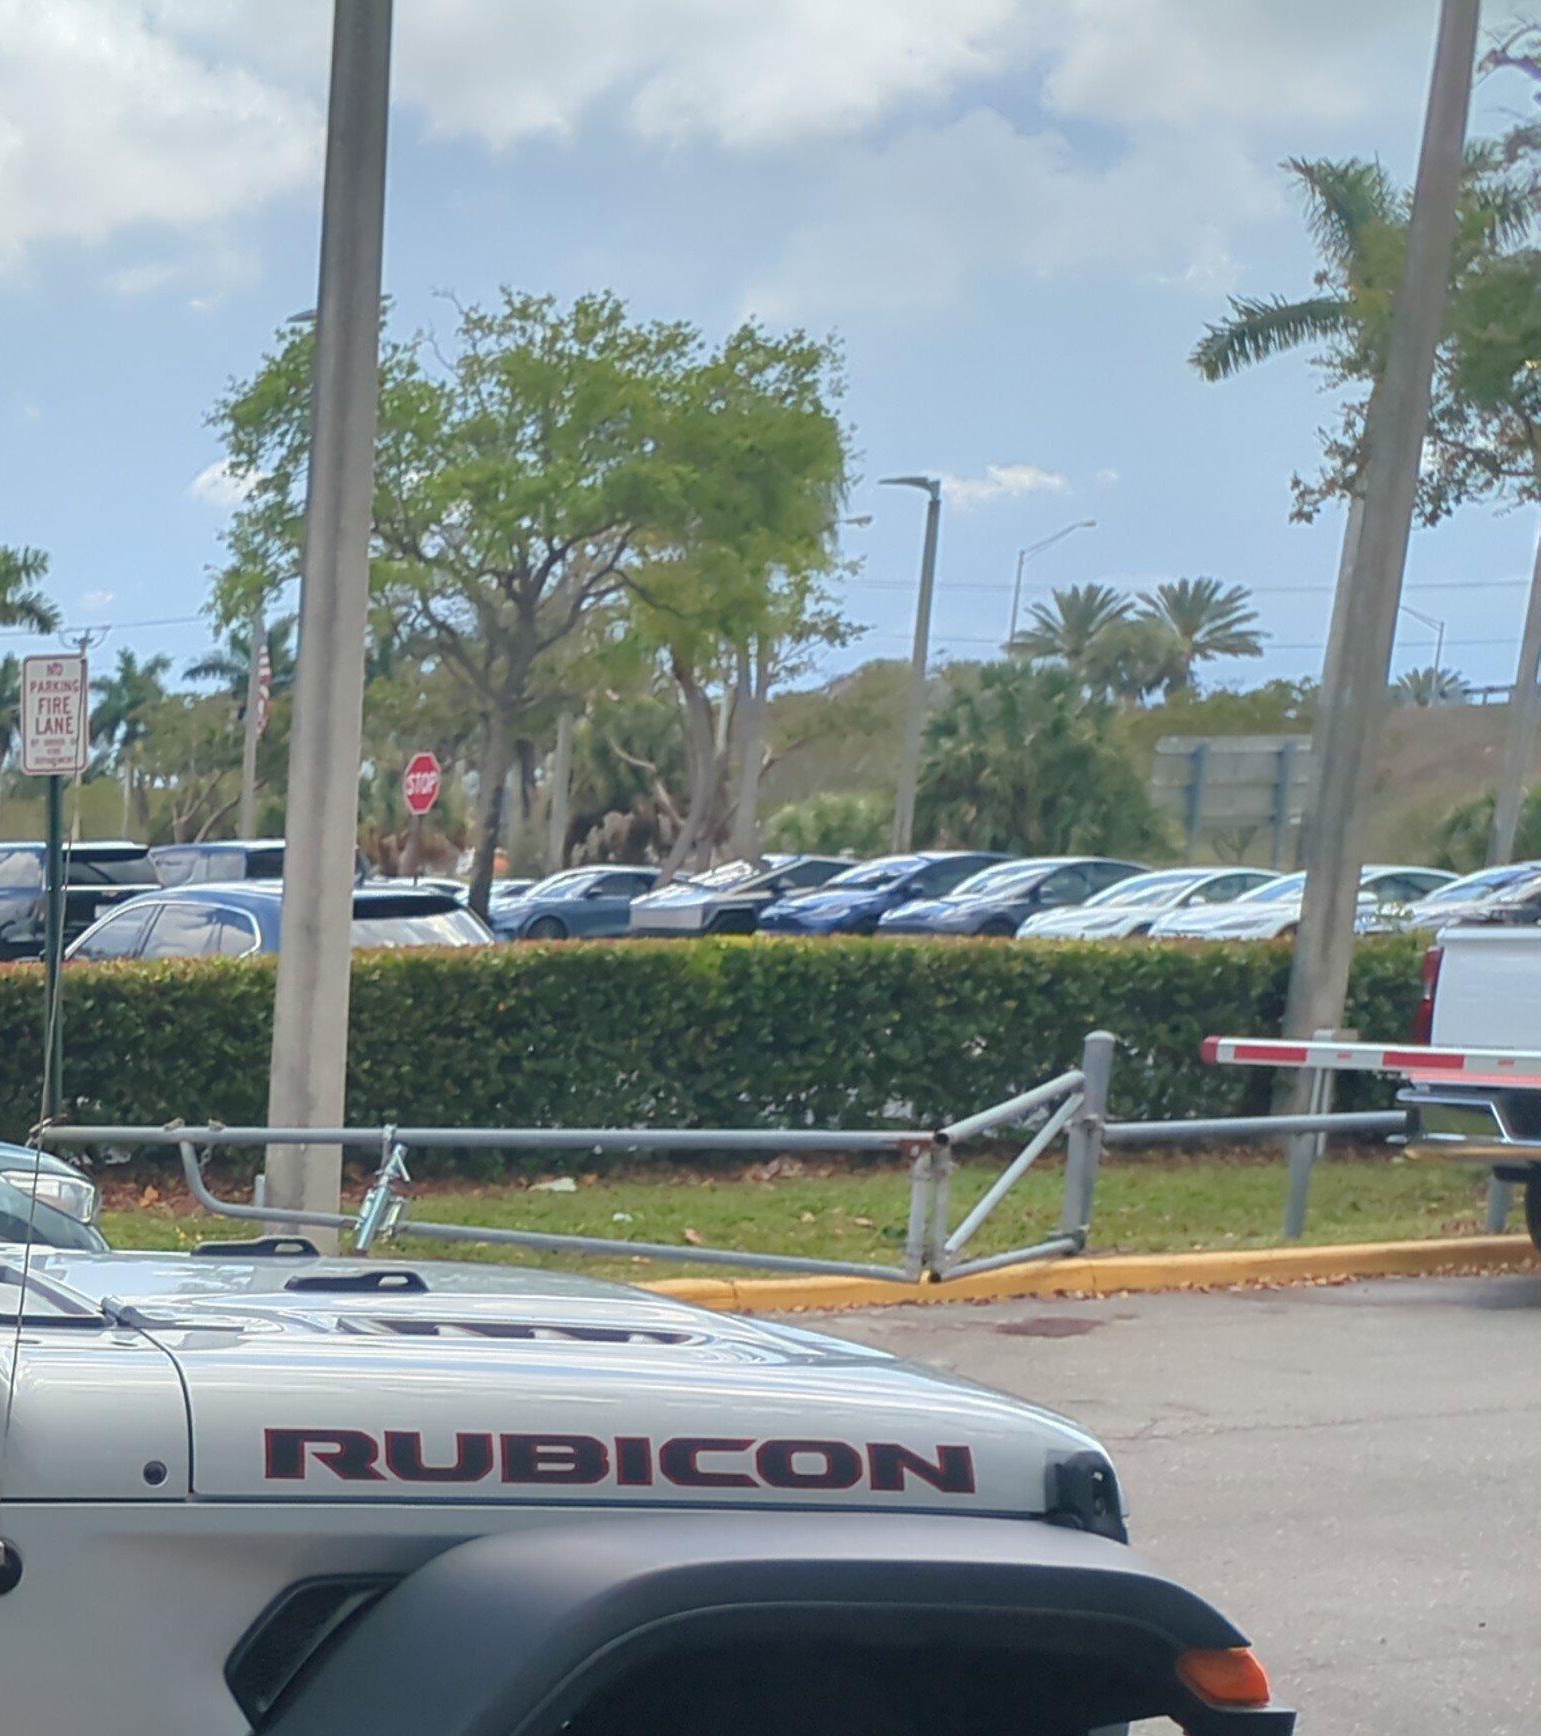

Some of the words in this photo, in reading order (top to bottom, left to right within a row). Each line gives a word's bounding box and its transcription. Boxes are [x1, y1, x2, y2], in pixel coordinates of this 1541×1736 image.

[46, 662, 64, 677] NO
[29, 679, 79, 694] PARKING
[38, 696, 71, 715] FIRE
[35, 716, 74, 735] LANE
[407, 771, 437, 795] STOP
[264, 1427, 976, 1494] RUBICON
